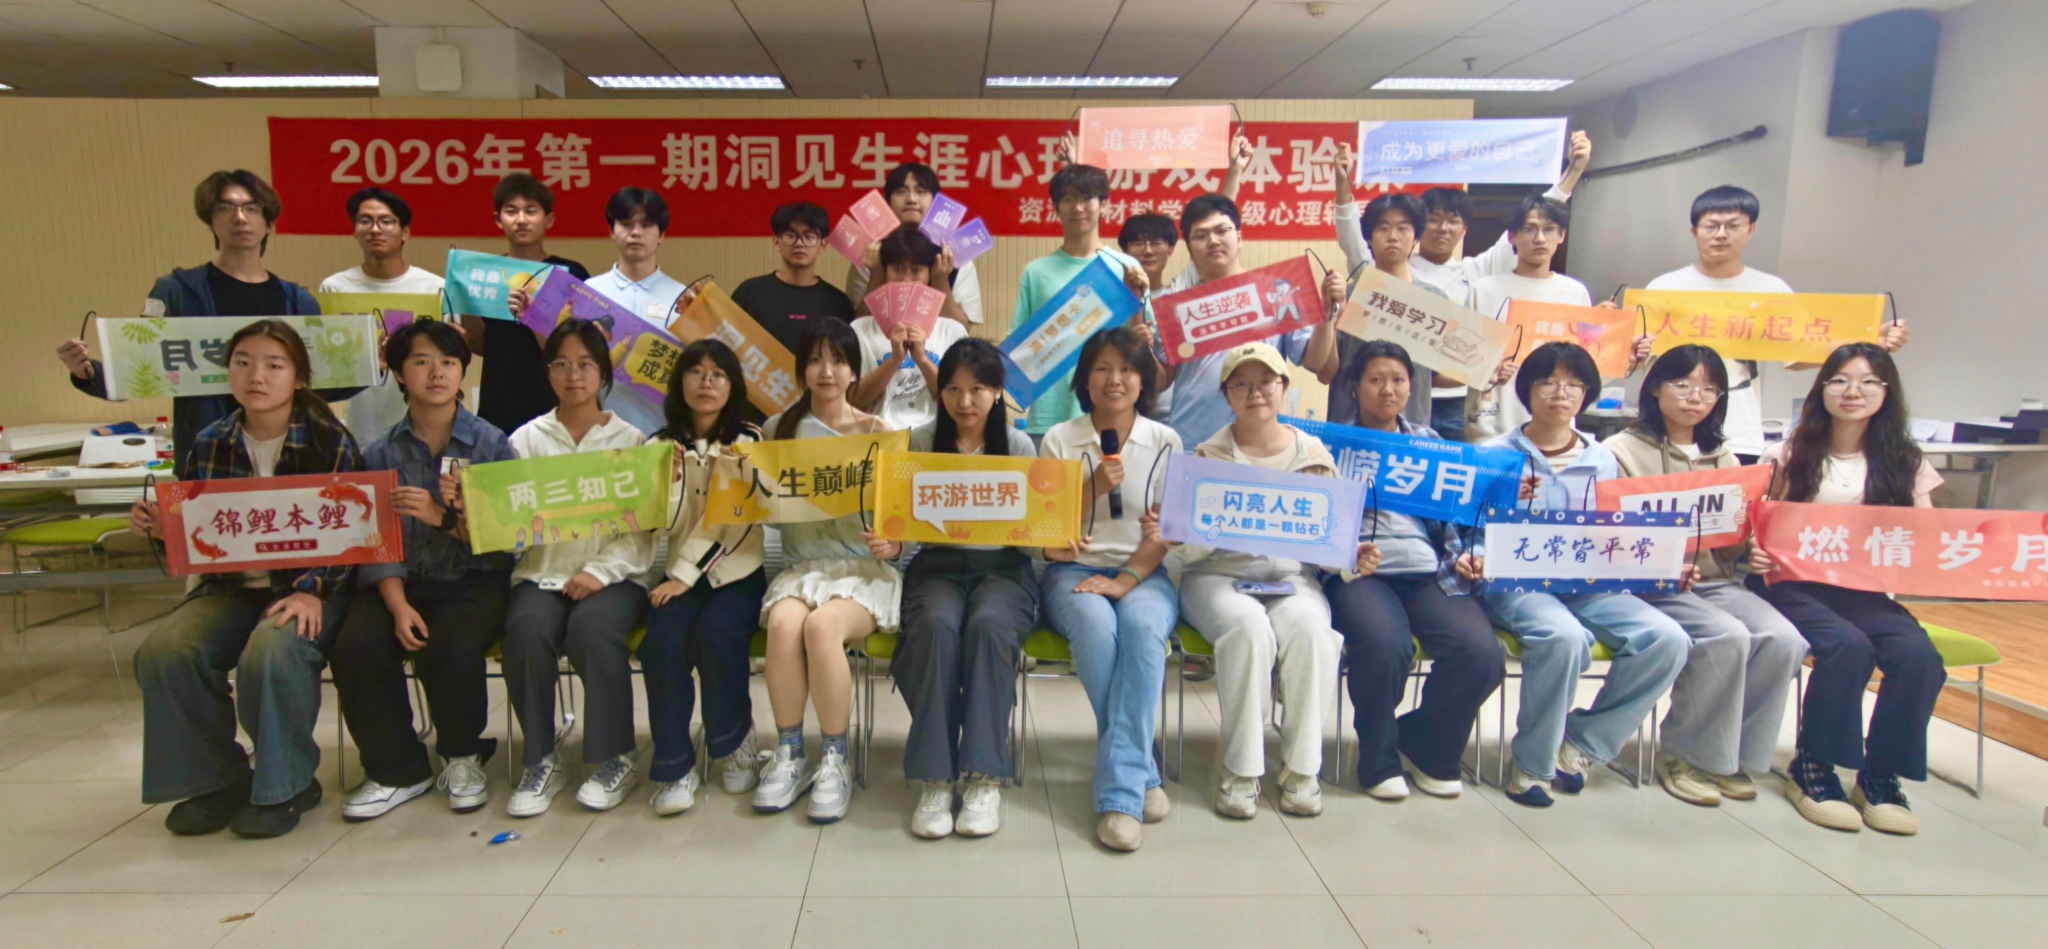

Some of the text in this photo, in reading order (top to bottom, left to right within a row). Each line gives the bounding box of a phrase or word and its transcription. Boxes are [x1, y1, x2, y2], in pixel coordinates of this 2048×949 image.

[1102, 128, 1200, 151] 追寻热爱
[1380, 141, 1536, 161] 成为更爱的自己
[1184, 291, 1252, 325] 人生逆袭
[1367, 291, 1447, 335] 我爱学习
[1655, 312, 1834, 343] 人生新起点
[706, 318, 801, 407] 洞见生
[1409, 439, 1463, 453] CAREER GAME
[744, 459, 875, 500] 人生巅峰
[1323, 445, 1477, 505] 嵘岁月
[507, 471, 640, 512] 两三知己
[917, 482, 1021, 508] 环游世界
[1223, 490, 1313, 517] 闪亮人生
[1699, 493, 1724, 513] IN
[210, 503, 350, 539] 锦鲤本鲤
[1201, 513, 1320, 535] 每个人都是一颗钻石
[1513, 535, 1655, 565] 无常皆平常
[1797, 525, 2048, 573] 燃情岁月
